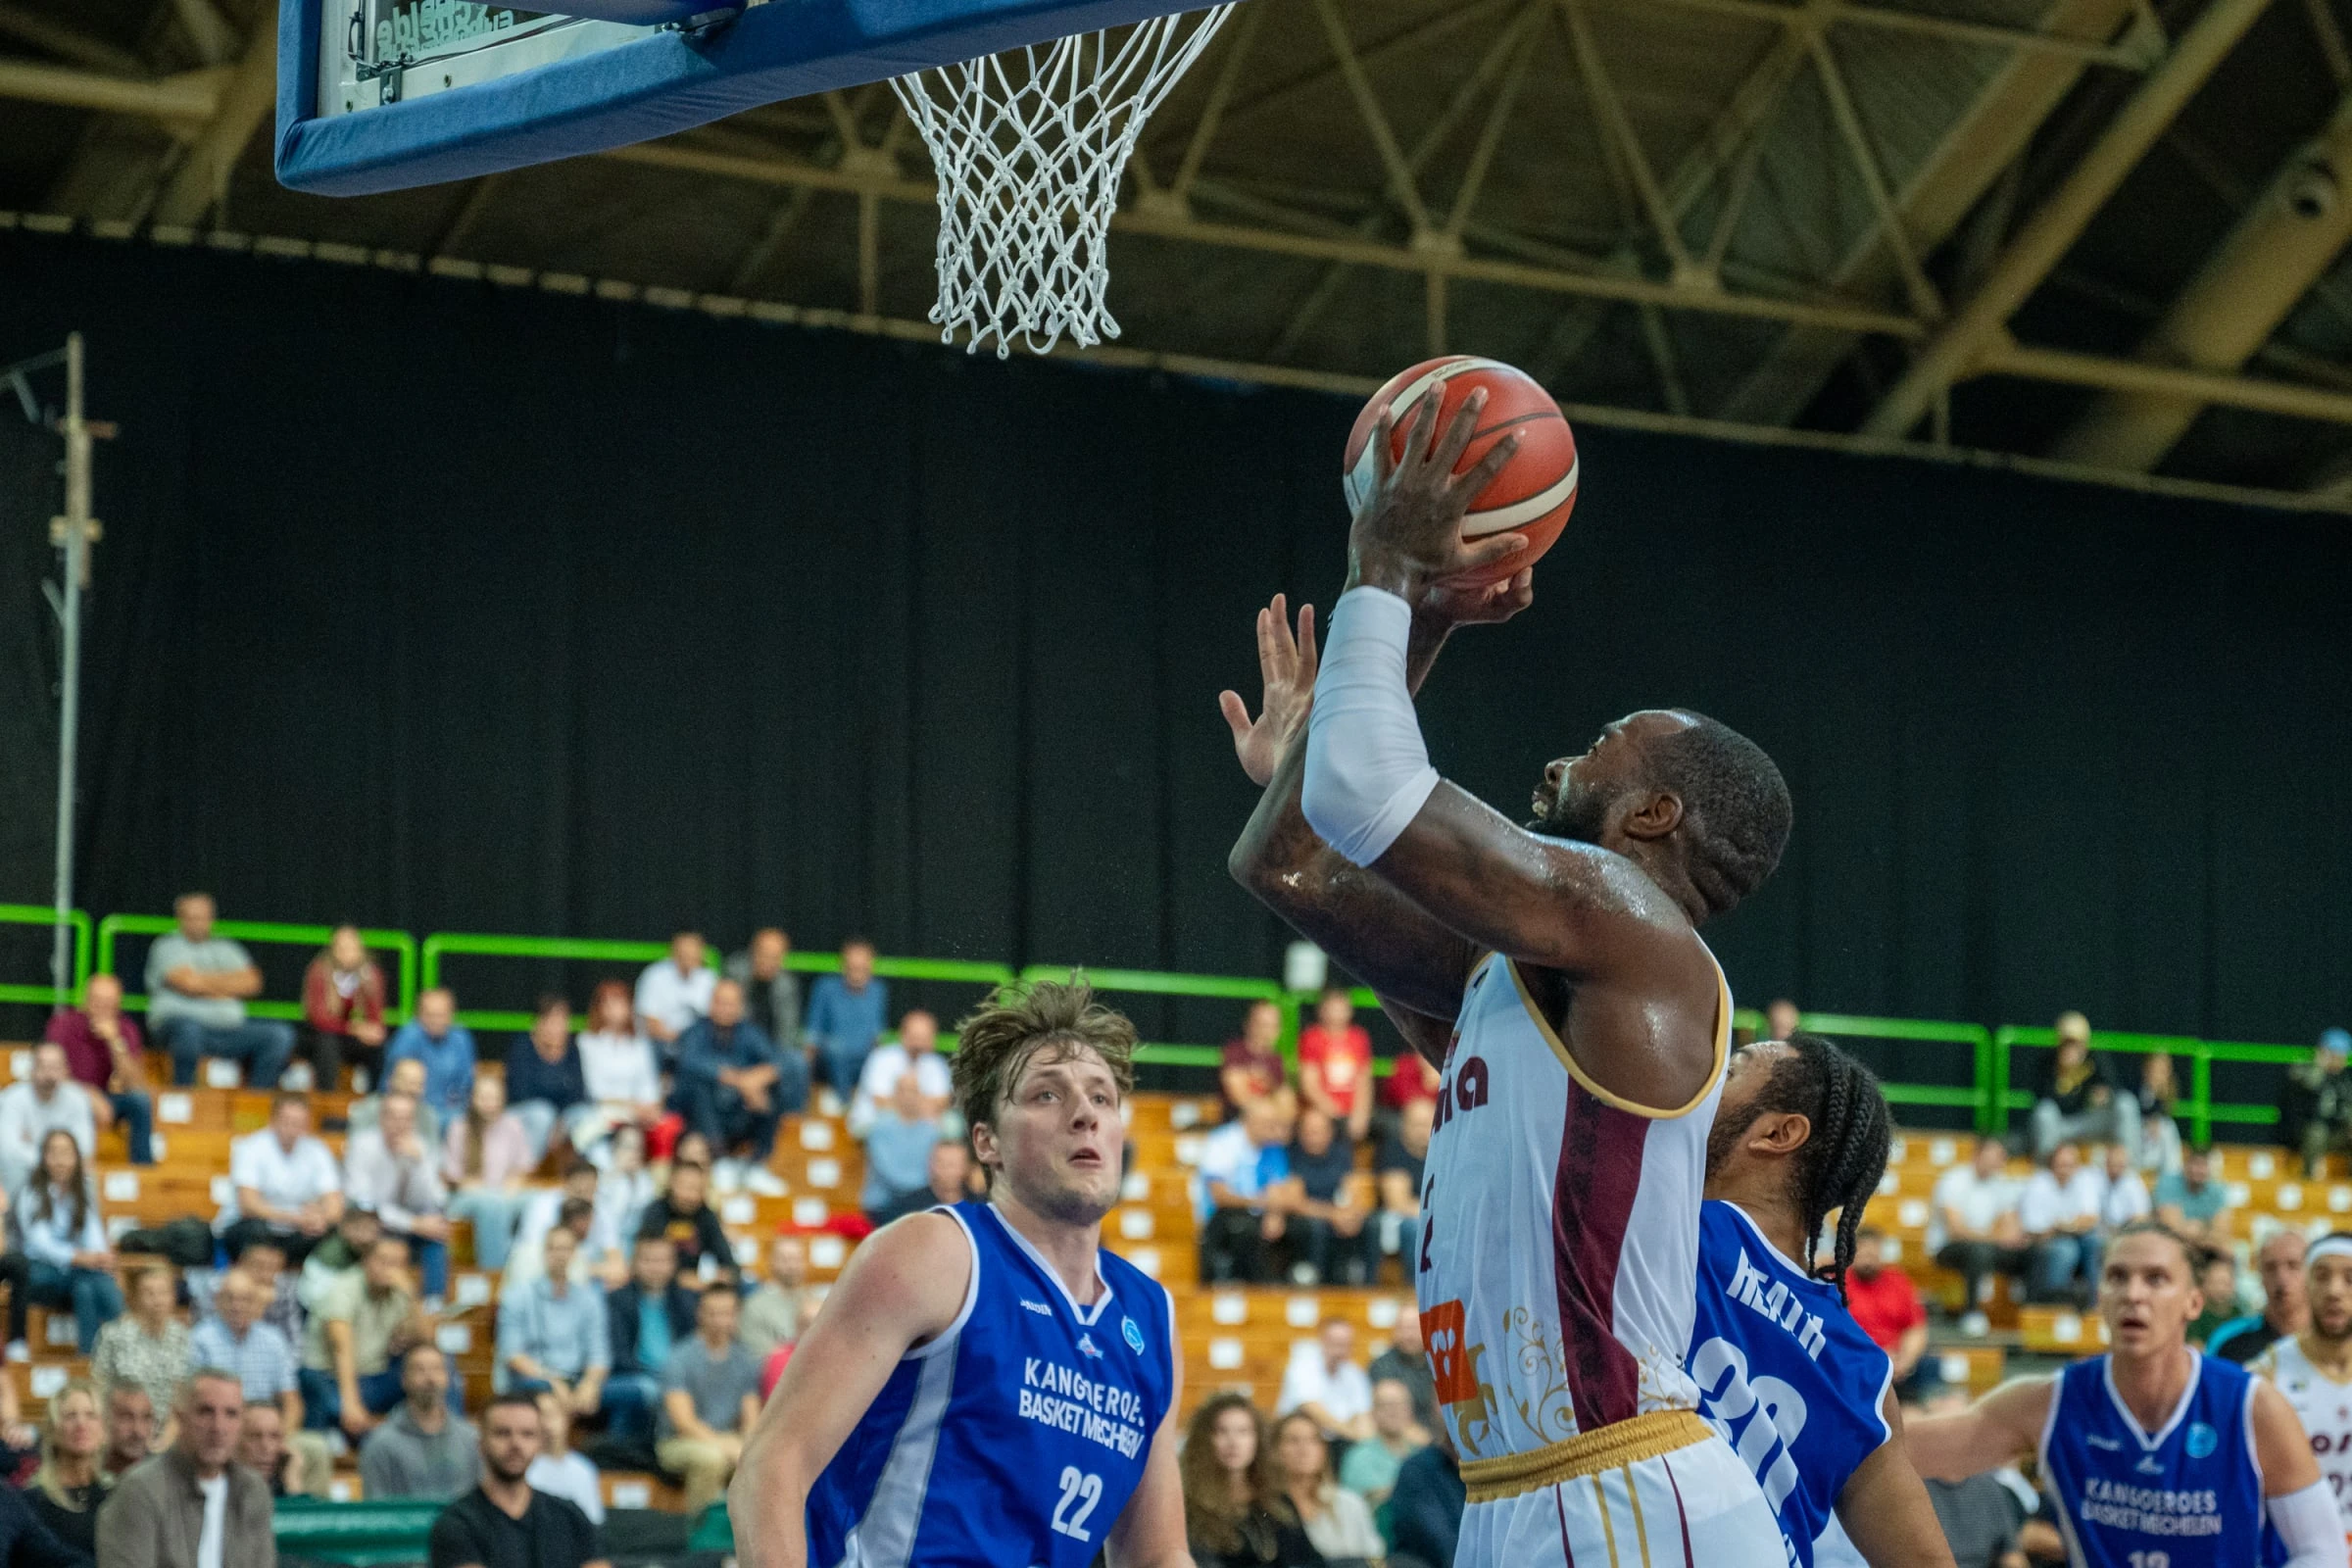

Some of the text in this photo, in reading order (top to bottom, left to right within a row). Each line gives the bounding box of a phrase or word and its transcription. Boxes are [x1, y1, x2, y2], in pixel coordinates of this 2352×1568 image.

[1018, 1388, 1084, 1435] BASKET
[1024, 1356, 1146, 1428] KANGOEROE
[1051, 1465, 1103, 1543] 22
